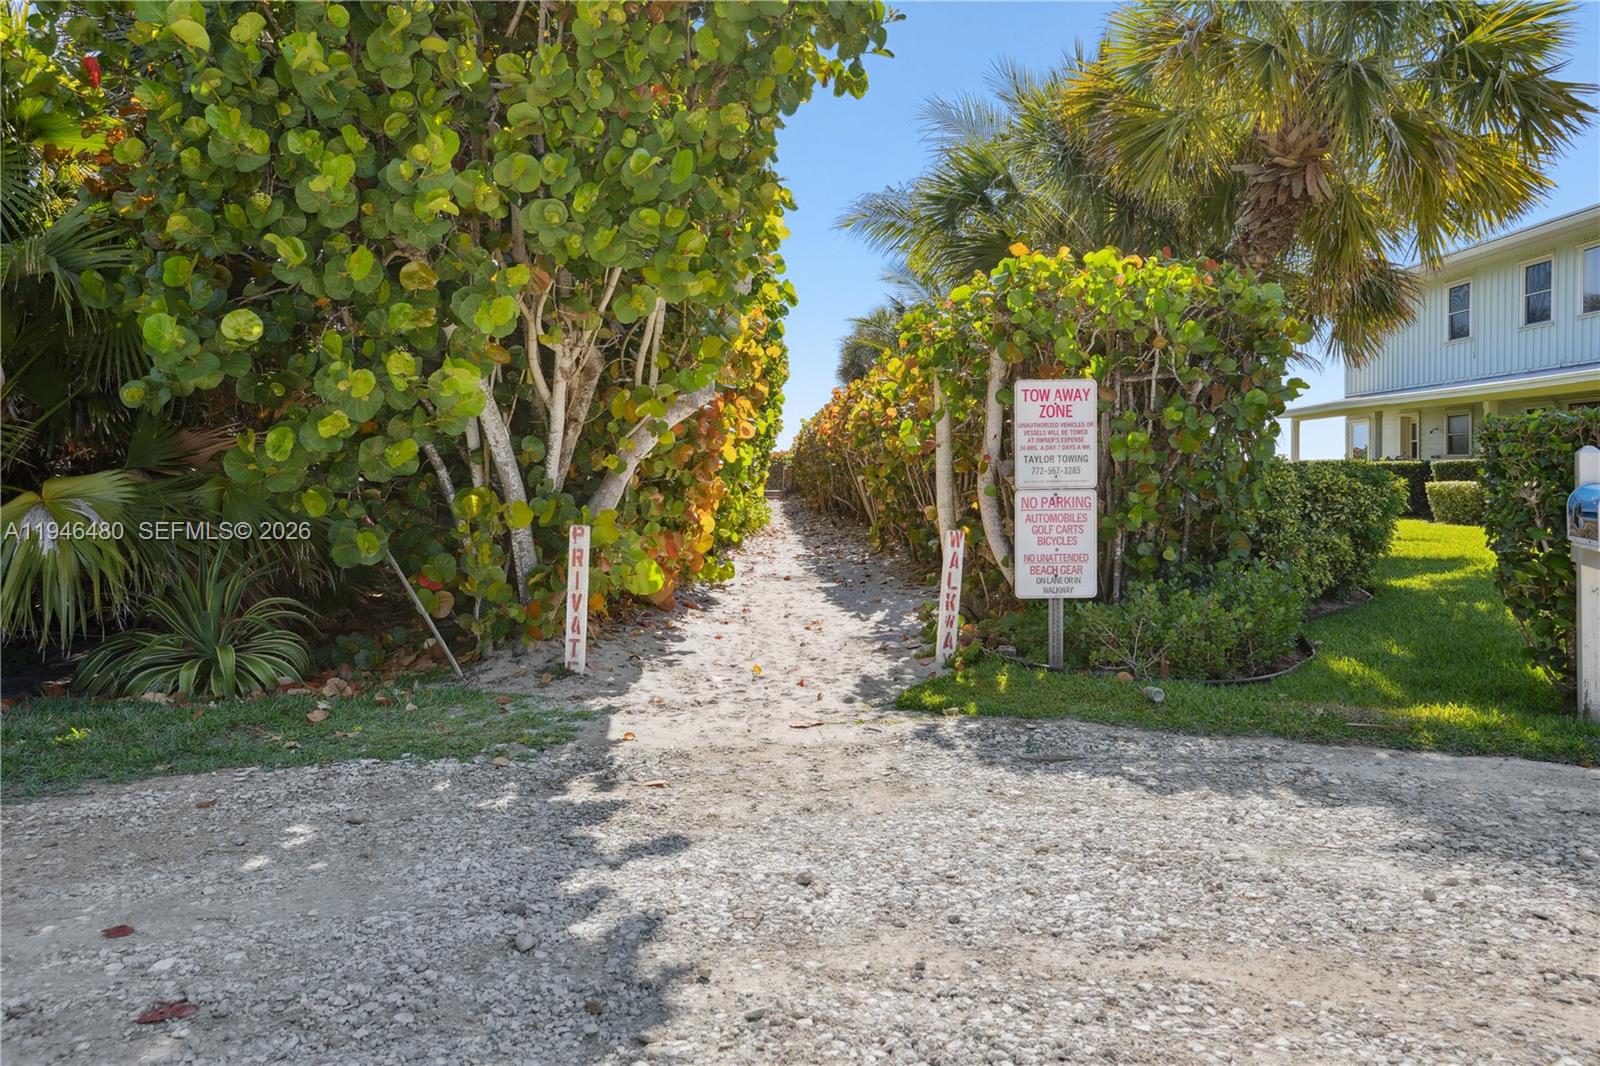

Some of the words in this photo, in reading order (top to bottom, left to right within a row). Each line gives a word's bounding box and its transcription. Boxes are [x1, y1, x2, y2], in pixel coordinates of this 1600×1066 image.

[1021, 388, 1050, 402] TOW
[1054, 388, 1091, 402] AWAY
[1039, 404, 1073, 418] ZONE
[1023, 455, 1054, 463] TAYLOR
[1057, 454, 1089, 463] TOWING
[1031, 466, 1081, 475] 772-567-3285
[1021, 497, 1037, 509] NO
[1041, 496, 1092, 508] PARKING
[1025, 513, 1088, 523] AUTOMOBILES
[1031, 525, 1054, 535] GOLF
[1056, 524, 1084, 534] CARTS
[1037, 536, 1078, 545] BICYCLES
[1023, 554, 1035, 562] NO
[1037, 554, 1089, 562] UNATTENDED
[1030, 566, 1058, 575] BEACH
[1060, 565, 1083, 575] GEAR
[1043, 586, 1074, 594] WALKWAY
